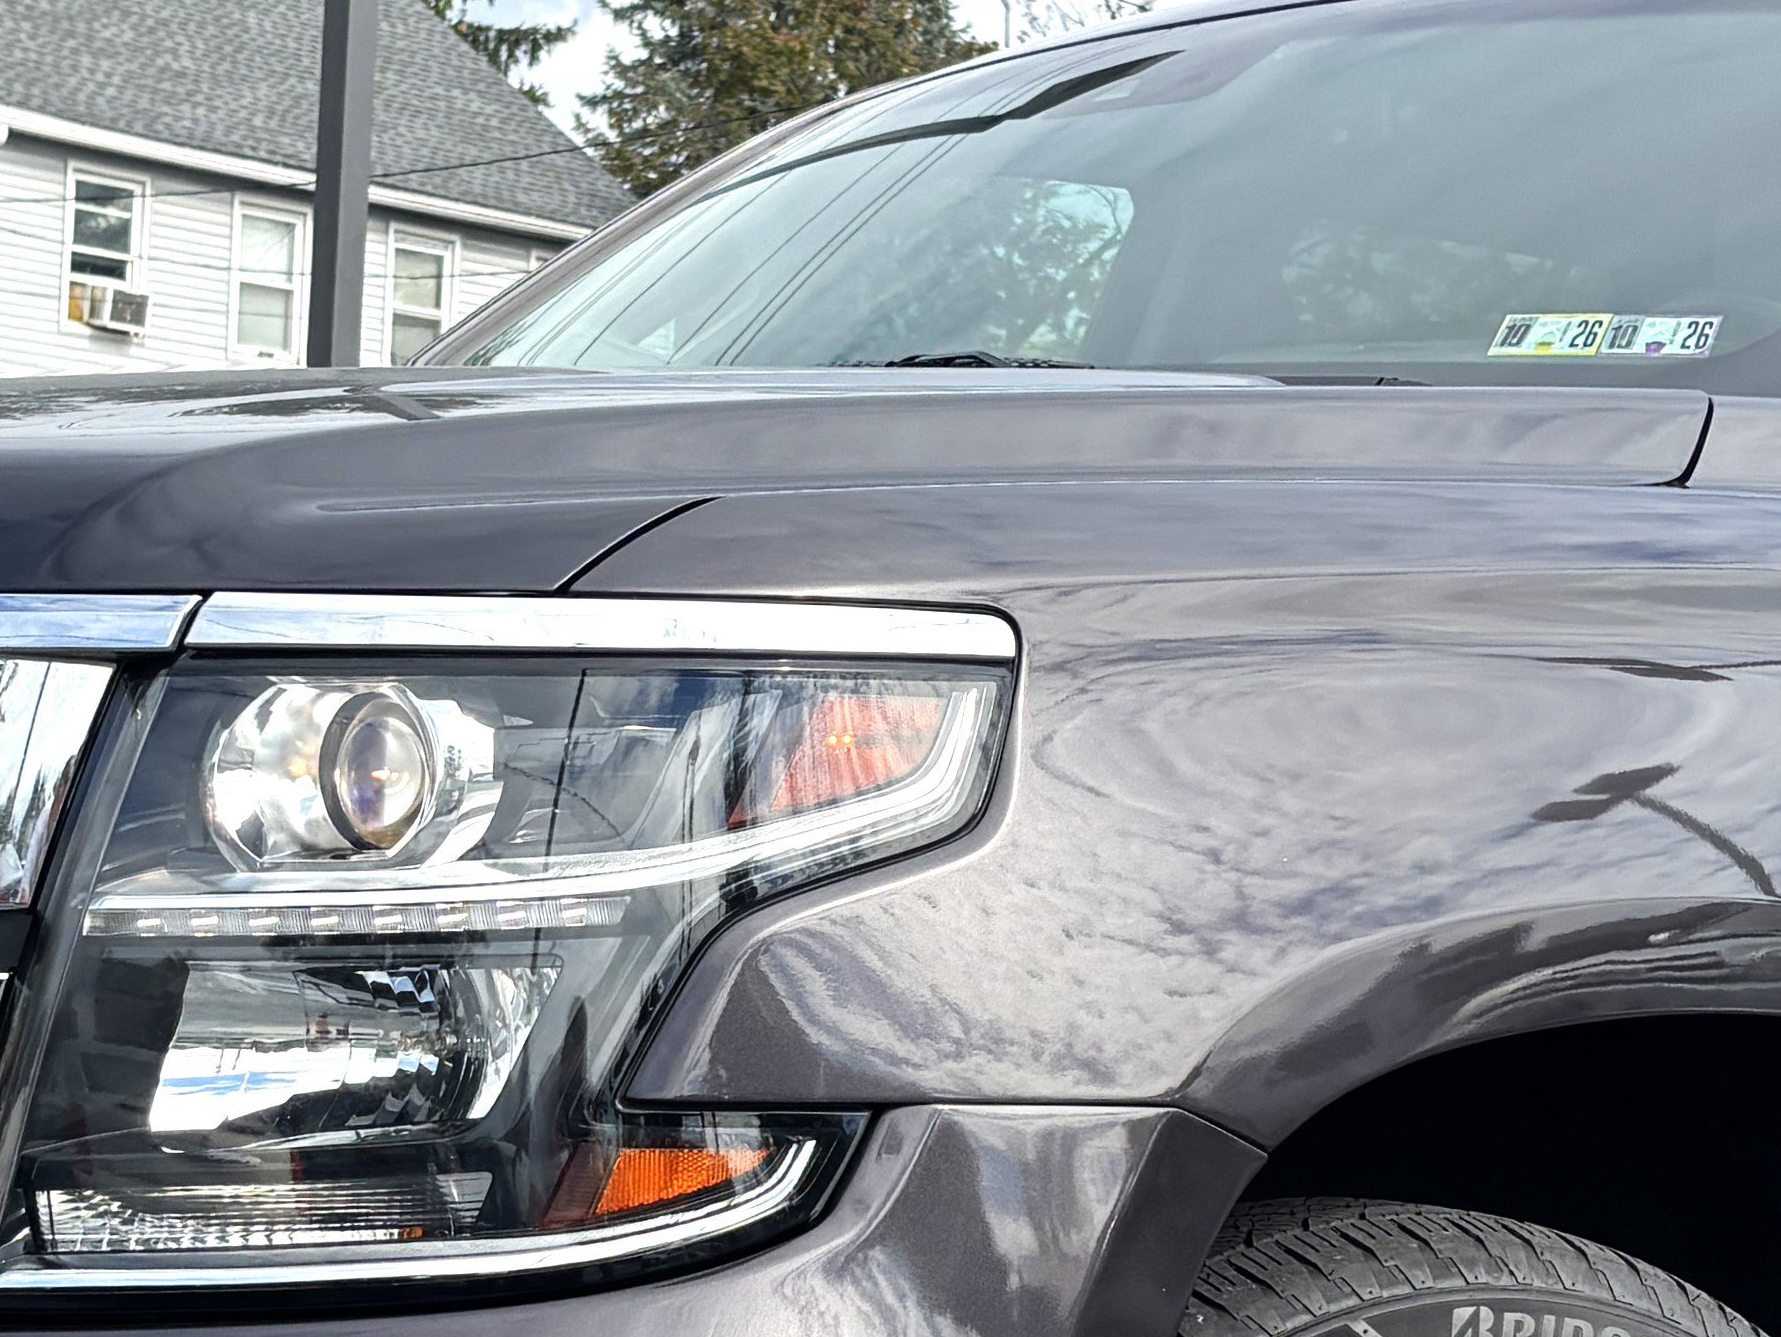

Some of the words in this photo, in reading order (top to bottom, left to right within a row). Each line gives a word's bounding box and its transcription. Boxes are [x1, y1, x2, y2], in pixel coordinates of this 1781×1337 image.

[1499, 323, 1532, 347] 10
[1568, 319, 1604, 348] 26
[1608, 324, 1640, 350] 10
[1680, 320, 1715, 350] 26
